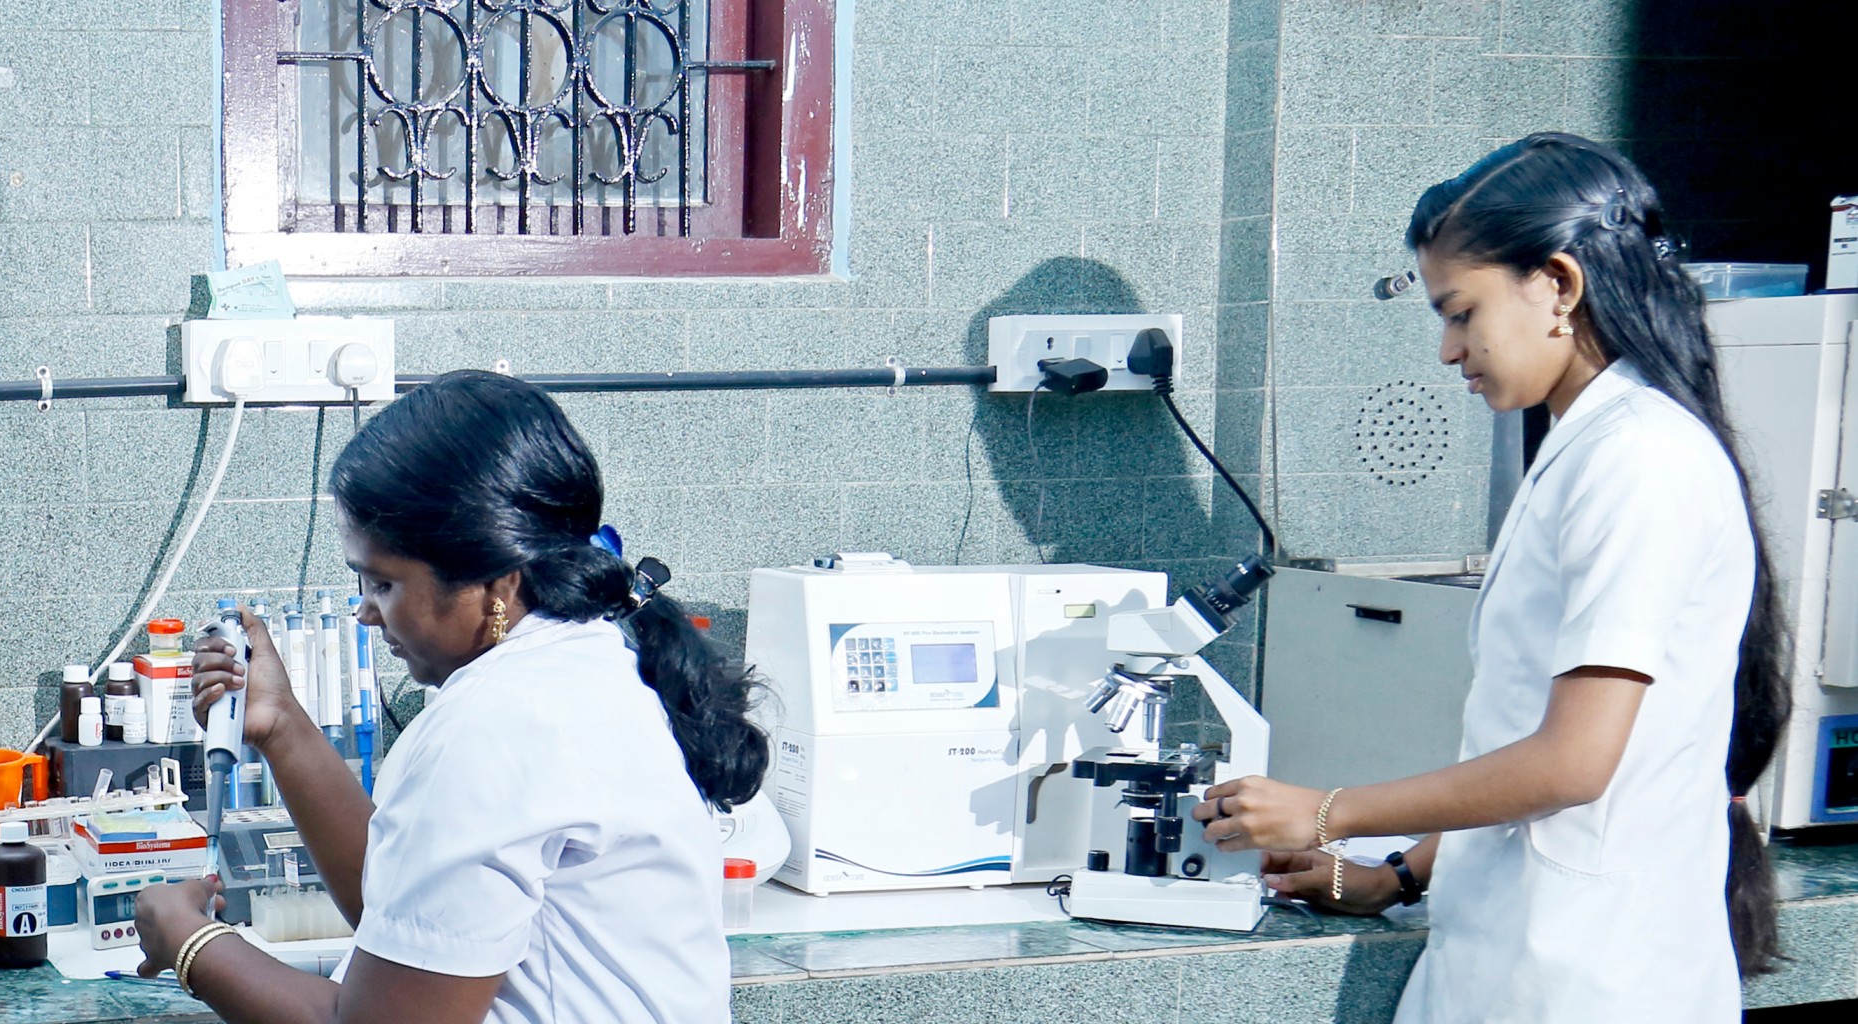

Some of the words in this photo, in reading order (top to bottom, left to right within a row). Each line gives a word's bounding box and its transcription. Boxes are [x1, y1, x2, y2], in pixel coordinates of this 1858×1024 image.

[948, 747, 976, 756] ST-200
[136, 842, 171, 851] BioSystems
[19, 914, 32, 934] A
